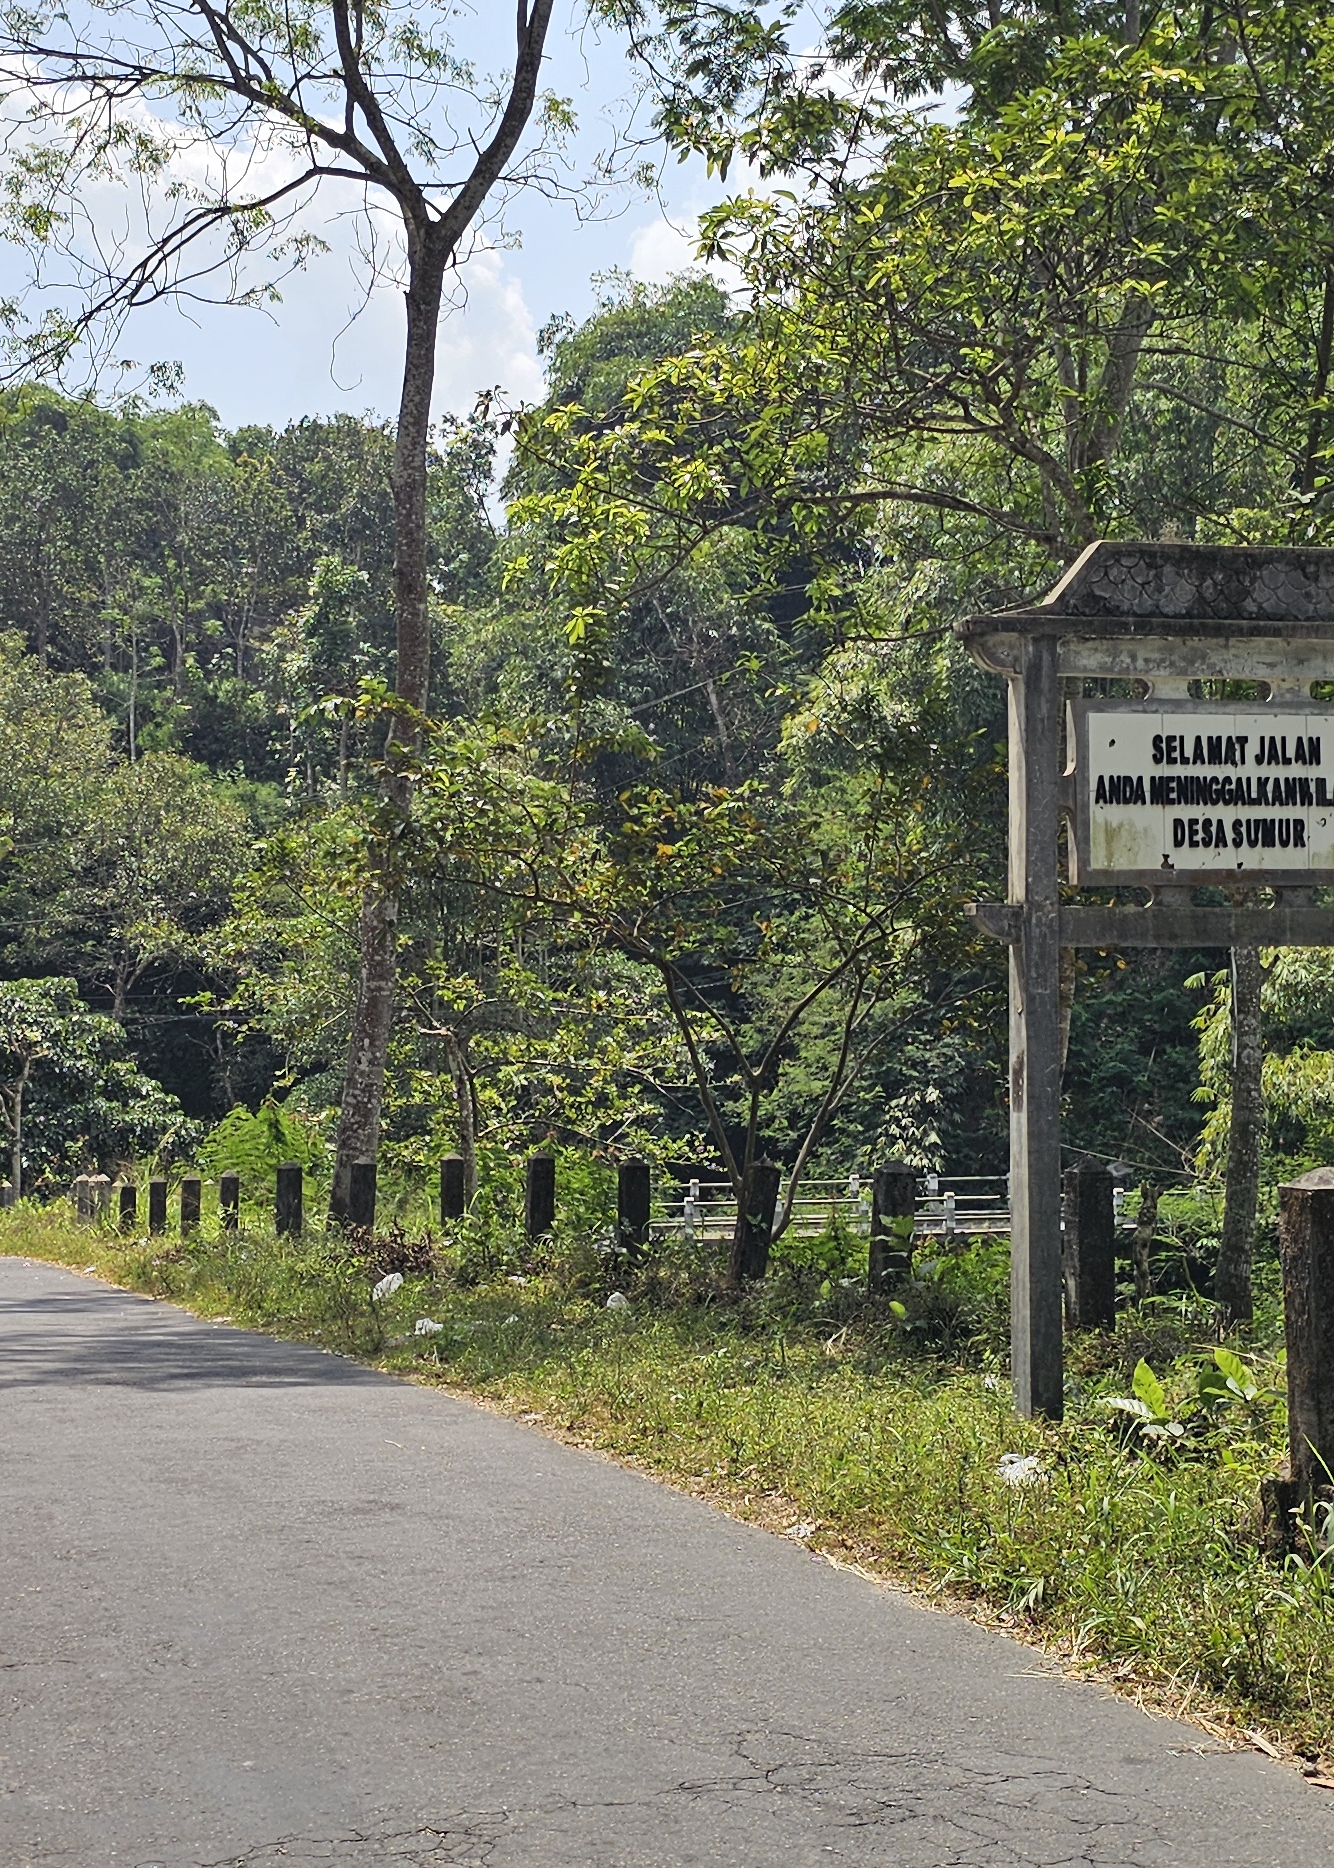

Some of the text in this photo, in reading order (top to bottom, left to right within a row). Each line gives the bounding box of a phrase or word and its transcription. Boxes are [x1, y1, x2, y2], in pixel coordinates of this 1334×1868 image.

[1151, 733, 1322, 767] SELAMAT JALAN
[1094, 774, 1147, 806] ANDA
[1149, 775, 1298, 808] MENINGGALKAN
[1172, 817, 1307, 850] DESA SUMUR
